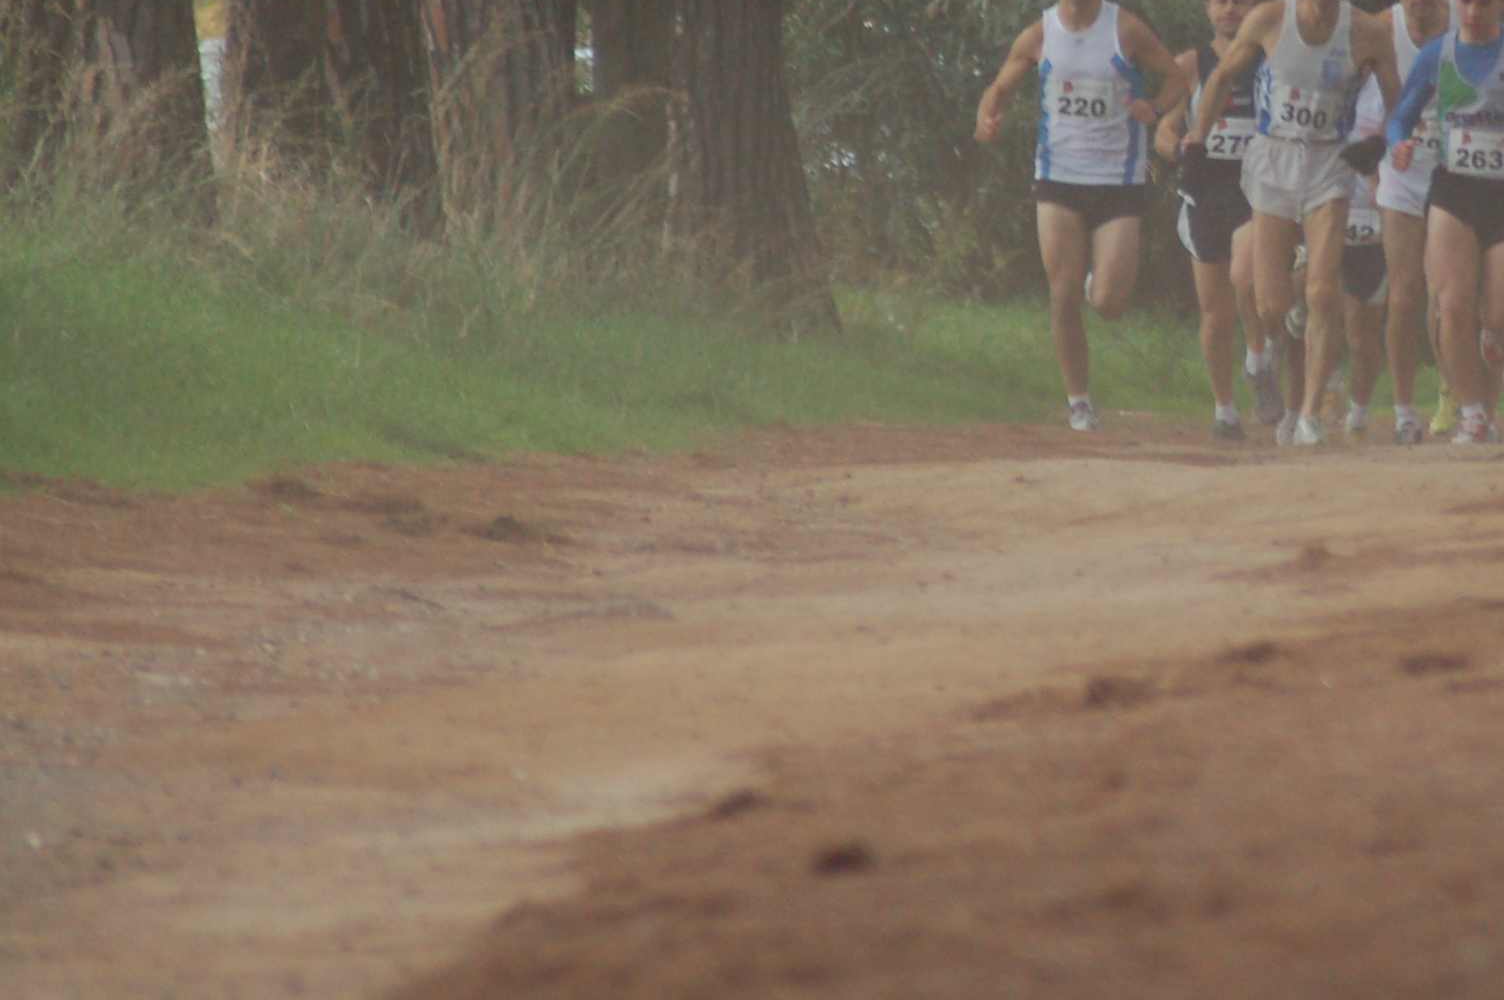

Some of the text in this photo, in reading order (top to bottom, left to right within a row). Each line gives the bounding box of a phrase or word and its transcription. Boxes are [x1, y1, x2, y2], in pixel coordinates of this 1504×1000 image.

[1057, 96, 1107, 118] 220
[1280, 102, 1327, 130] 300
[1455, 147, 1504, 170] 263
